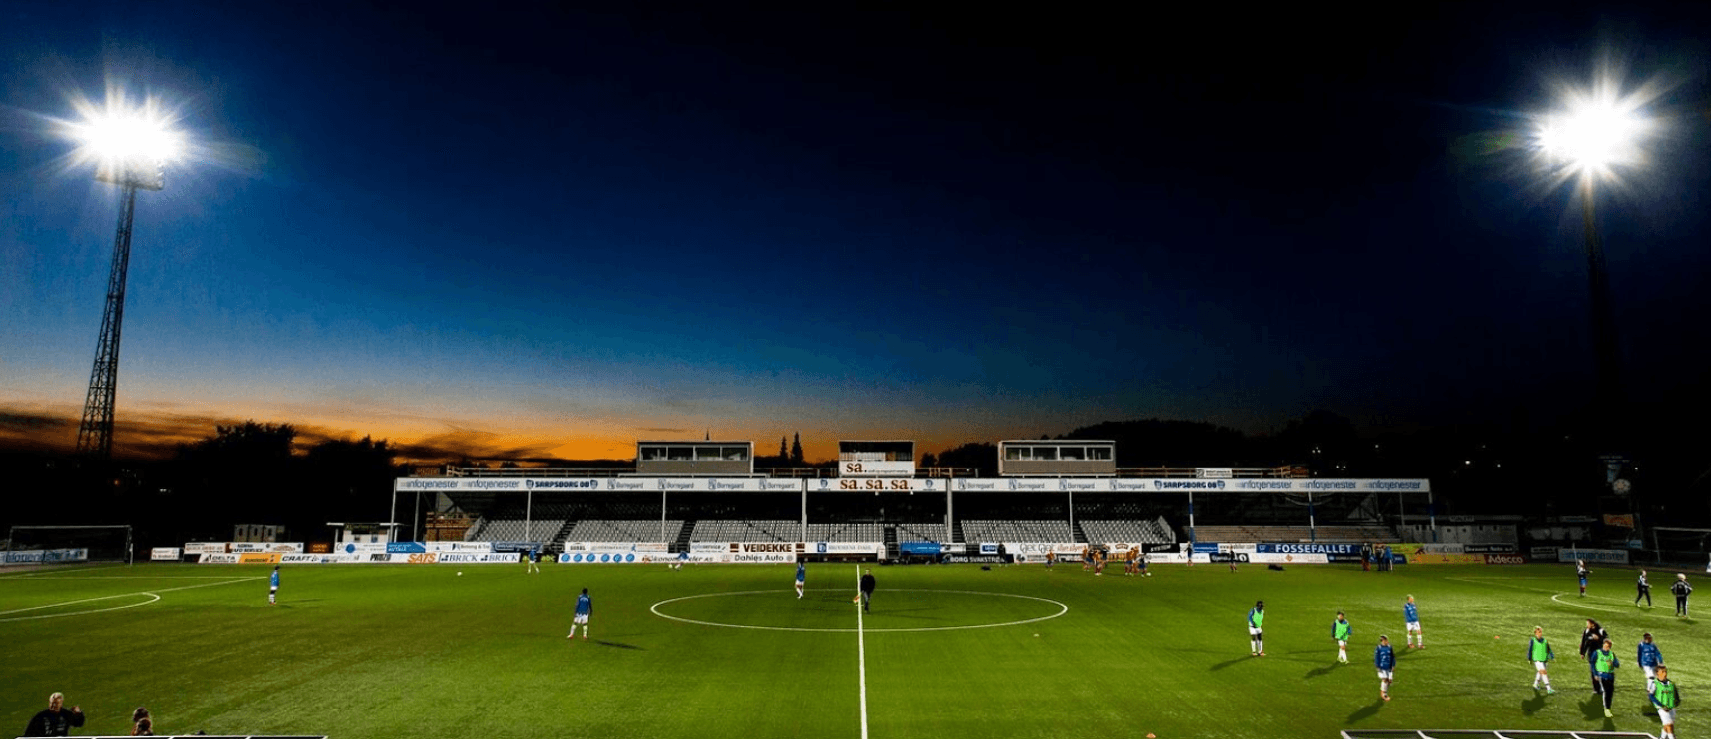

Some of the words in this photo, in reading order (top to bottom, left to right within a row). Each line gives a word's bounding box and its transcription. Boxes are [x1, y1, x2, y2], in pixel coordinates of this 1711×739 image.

[847, 463, 867, 473] sa.
[743, 544, 792, 553] VEIDEKKE
[1275, 544, 1352, 553] FOSSEFALLET
[408, 553, 436, 563] SATS
[449, 554, 478, 562] BRICK
[488, 554, 518, 562] BRICK
[734, 554, 762, 562] Dahles
[765, 554, 784, 562] Auto
[1487, 554, 1523, 563] Adecco
